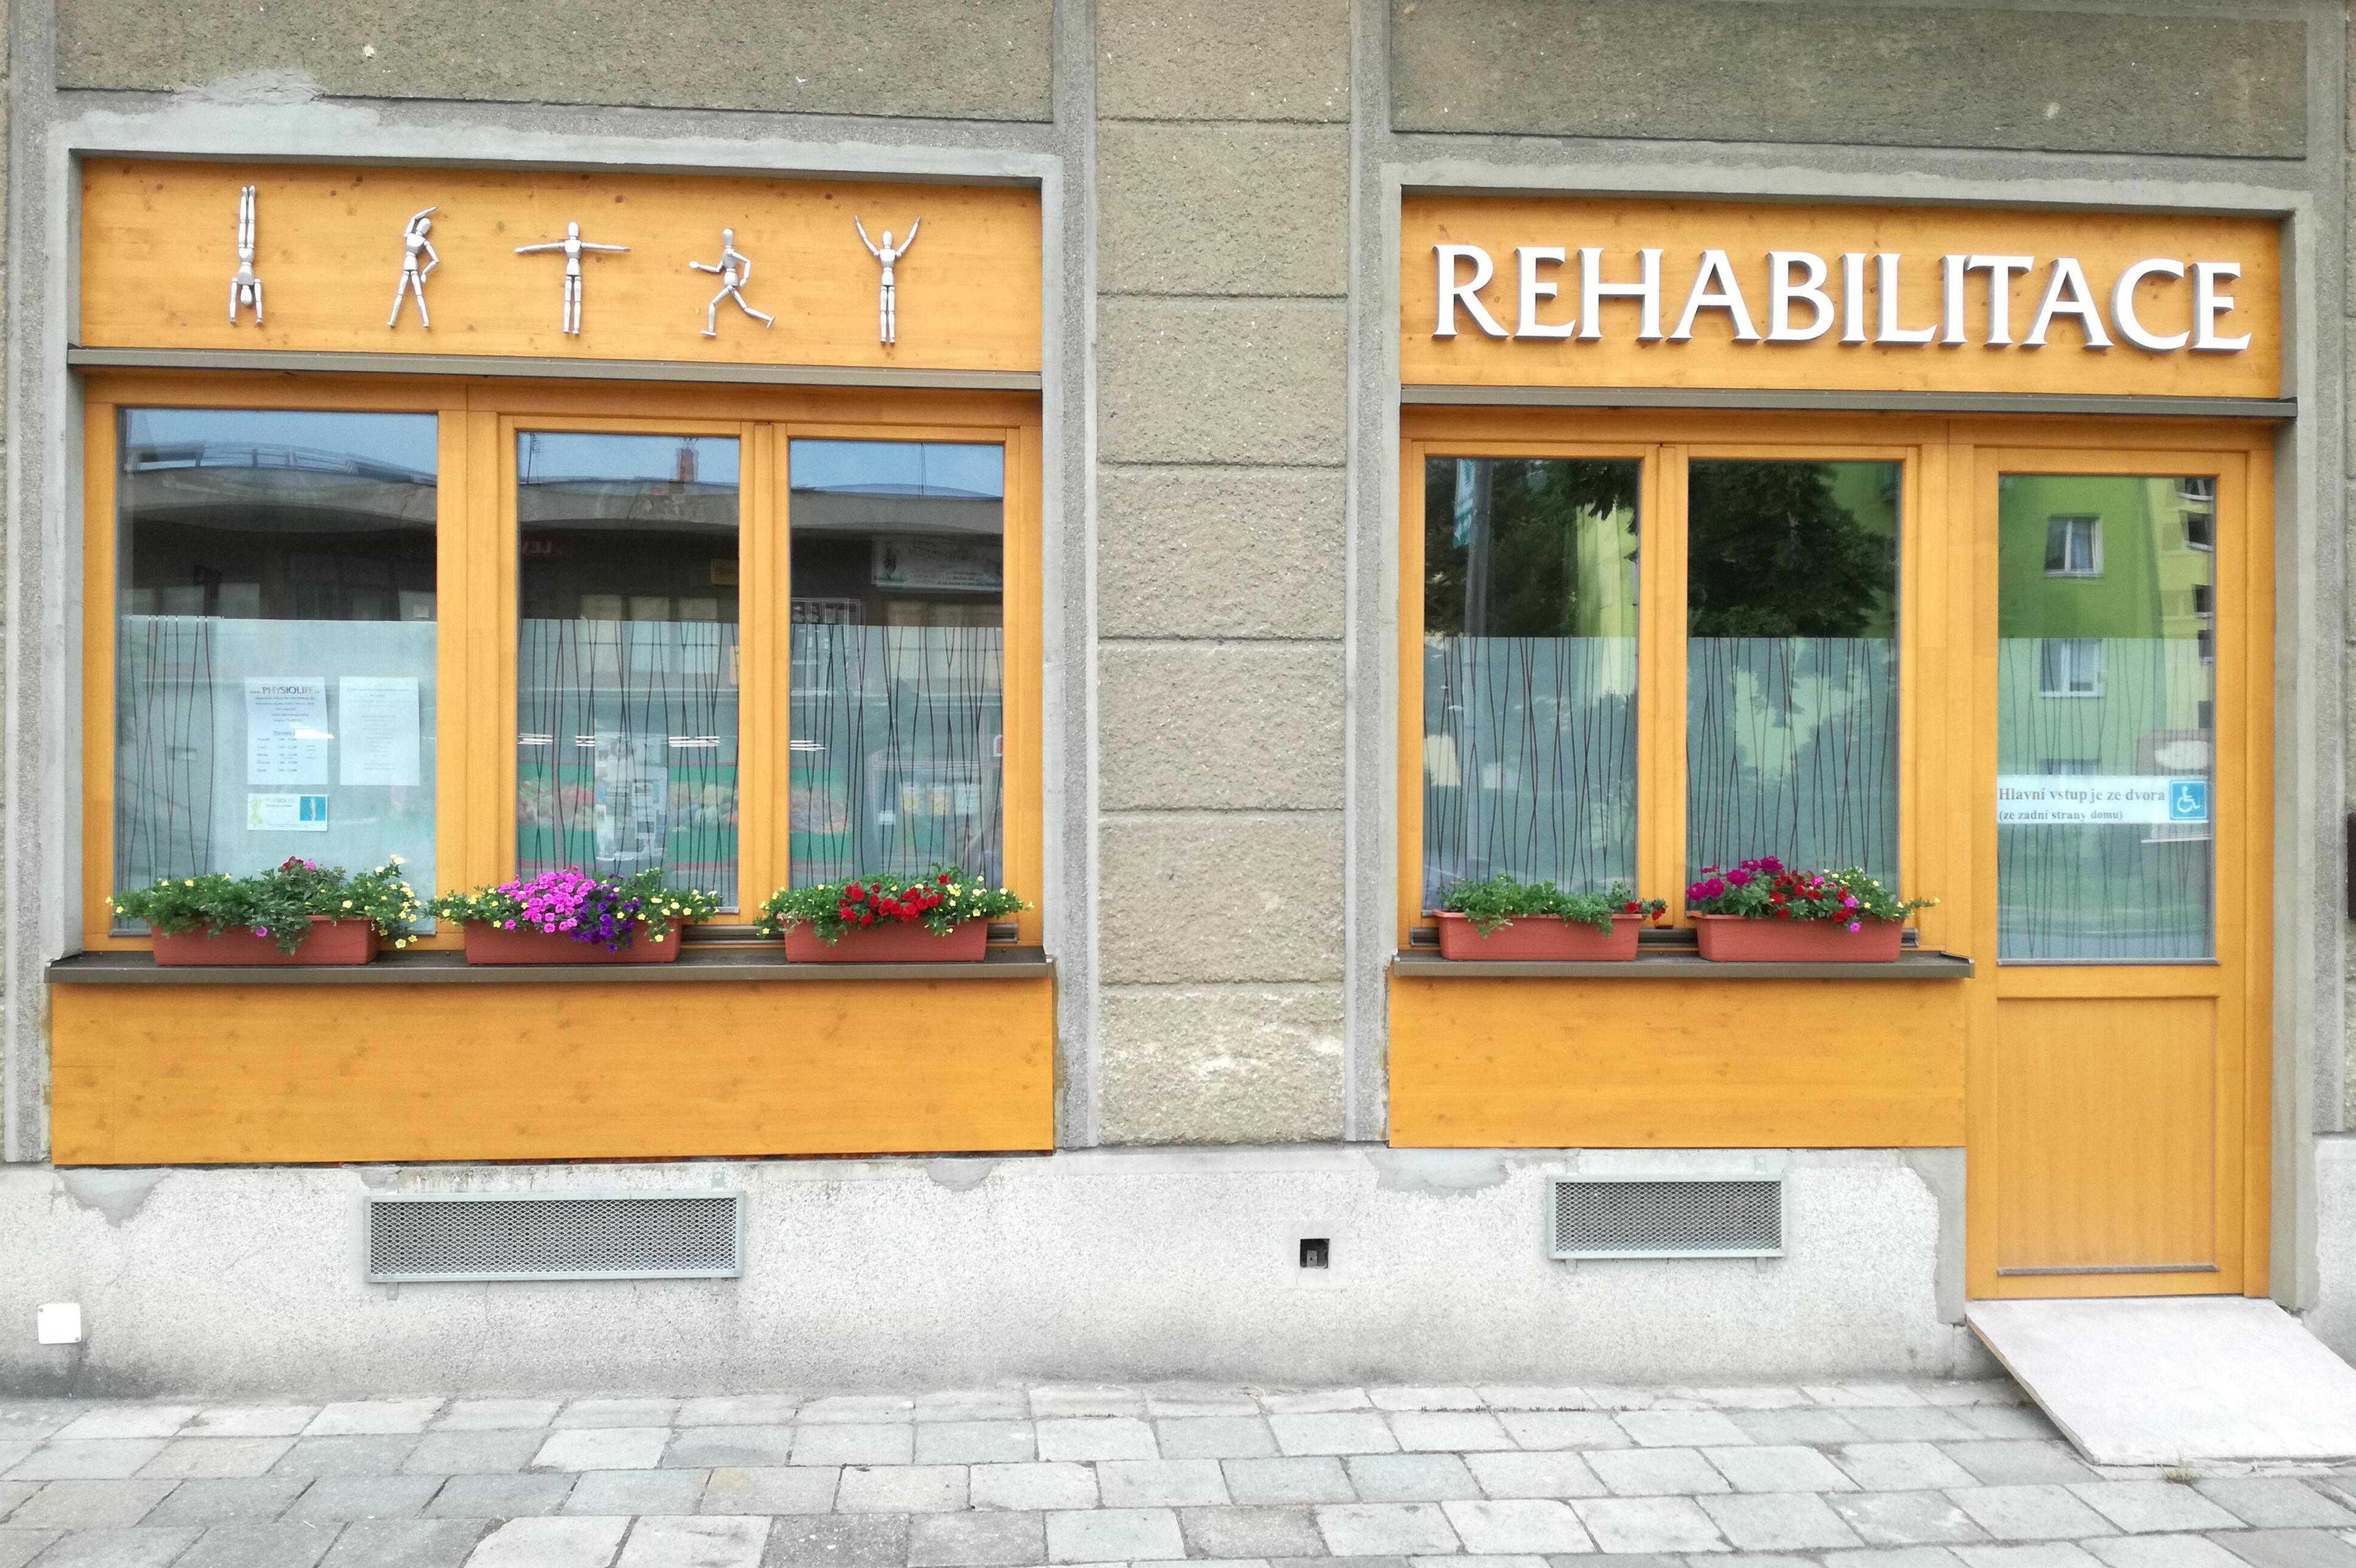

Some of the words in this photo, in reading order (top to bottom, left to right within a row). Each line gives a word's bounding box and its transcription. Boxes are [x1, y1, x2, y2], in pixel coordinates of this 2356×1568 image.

[1432, 244, 2252, 352] REHABILITACE
[1999, 787, 2046, 800] Hlavní
[2050, 789, 2087, 803] vstup
[2090, 789, 2102, 803] je
[2107, 791, 2121, 801] ze
[2125, 789, 2164, 801] dvora
[1999, 810, 2014, 821] (ze
[2018, 809, 2048, 819] zadní
[2051, 811, 2085, 821] strany
[2090, 810, 2123, 820] domu)
